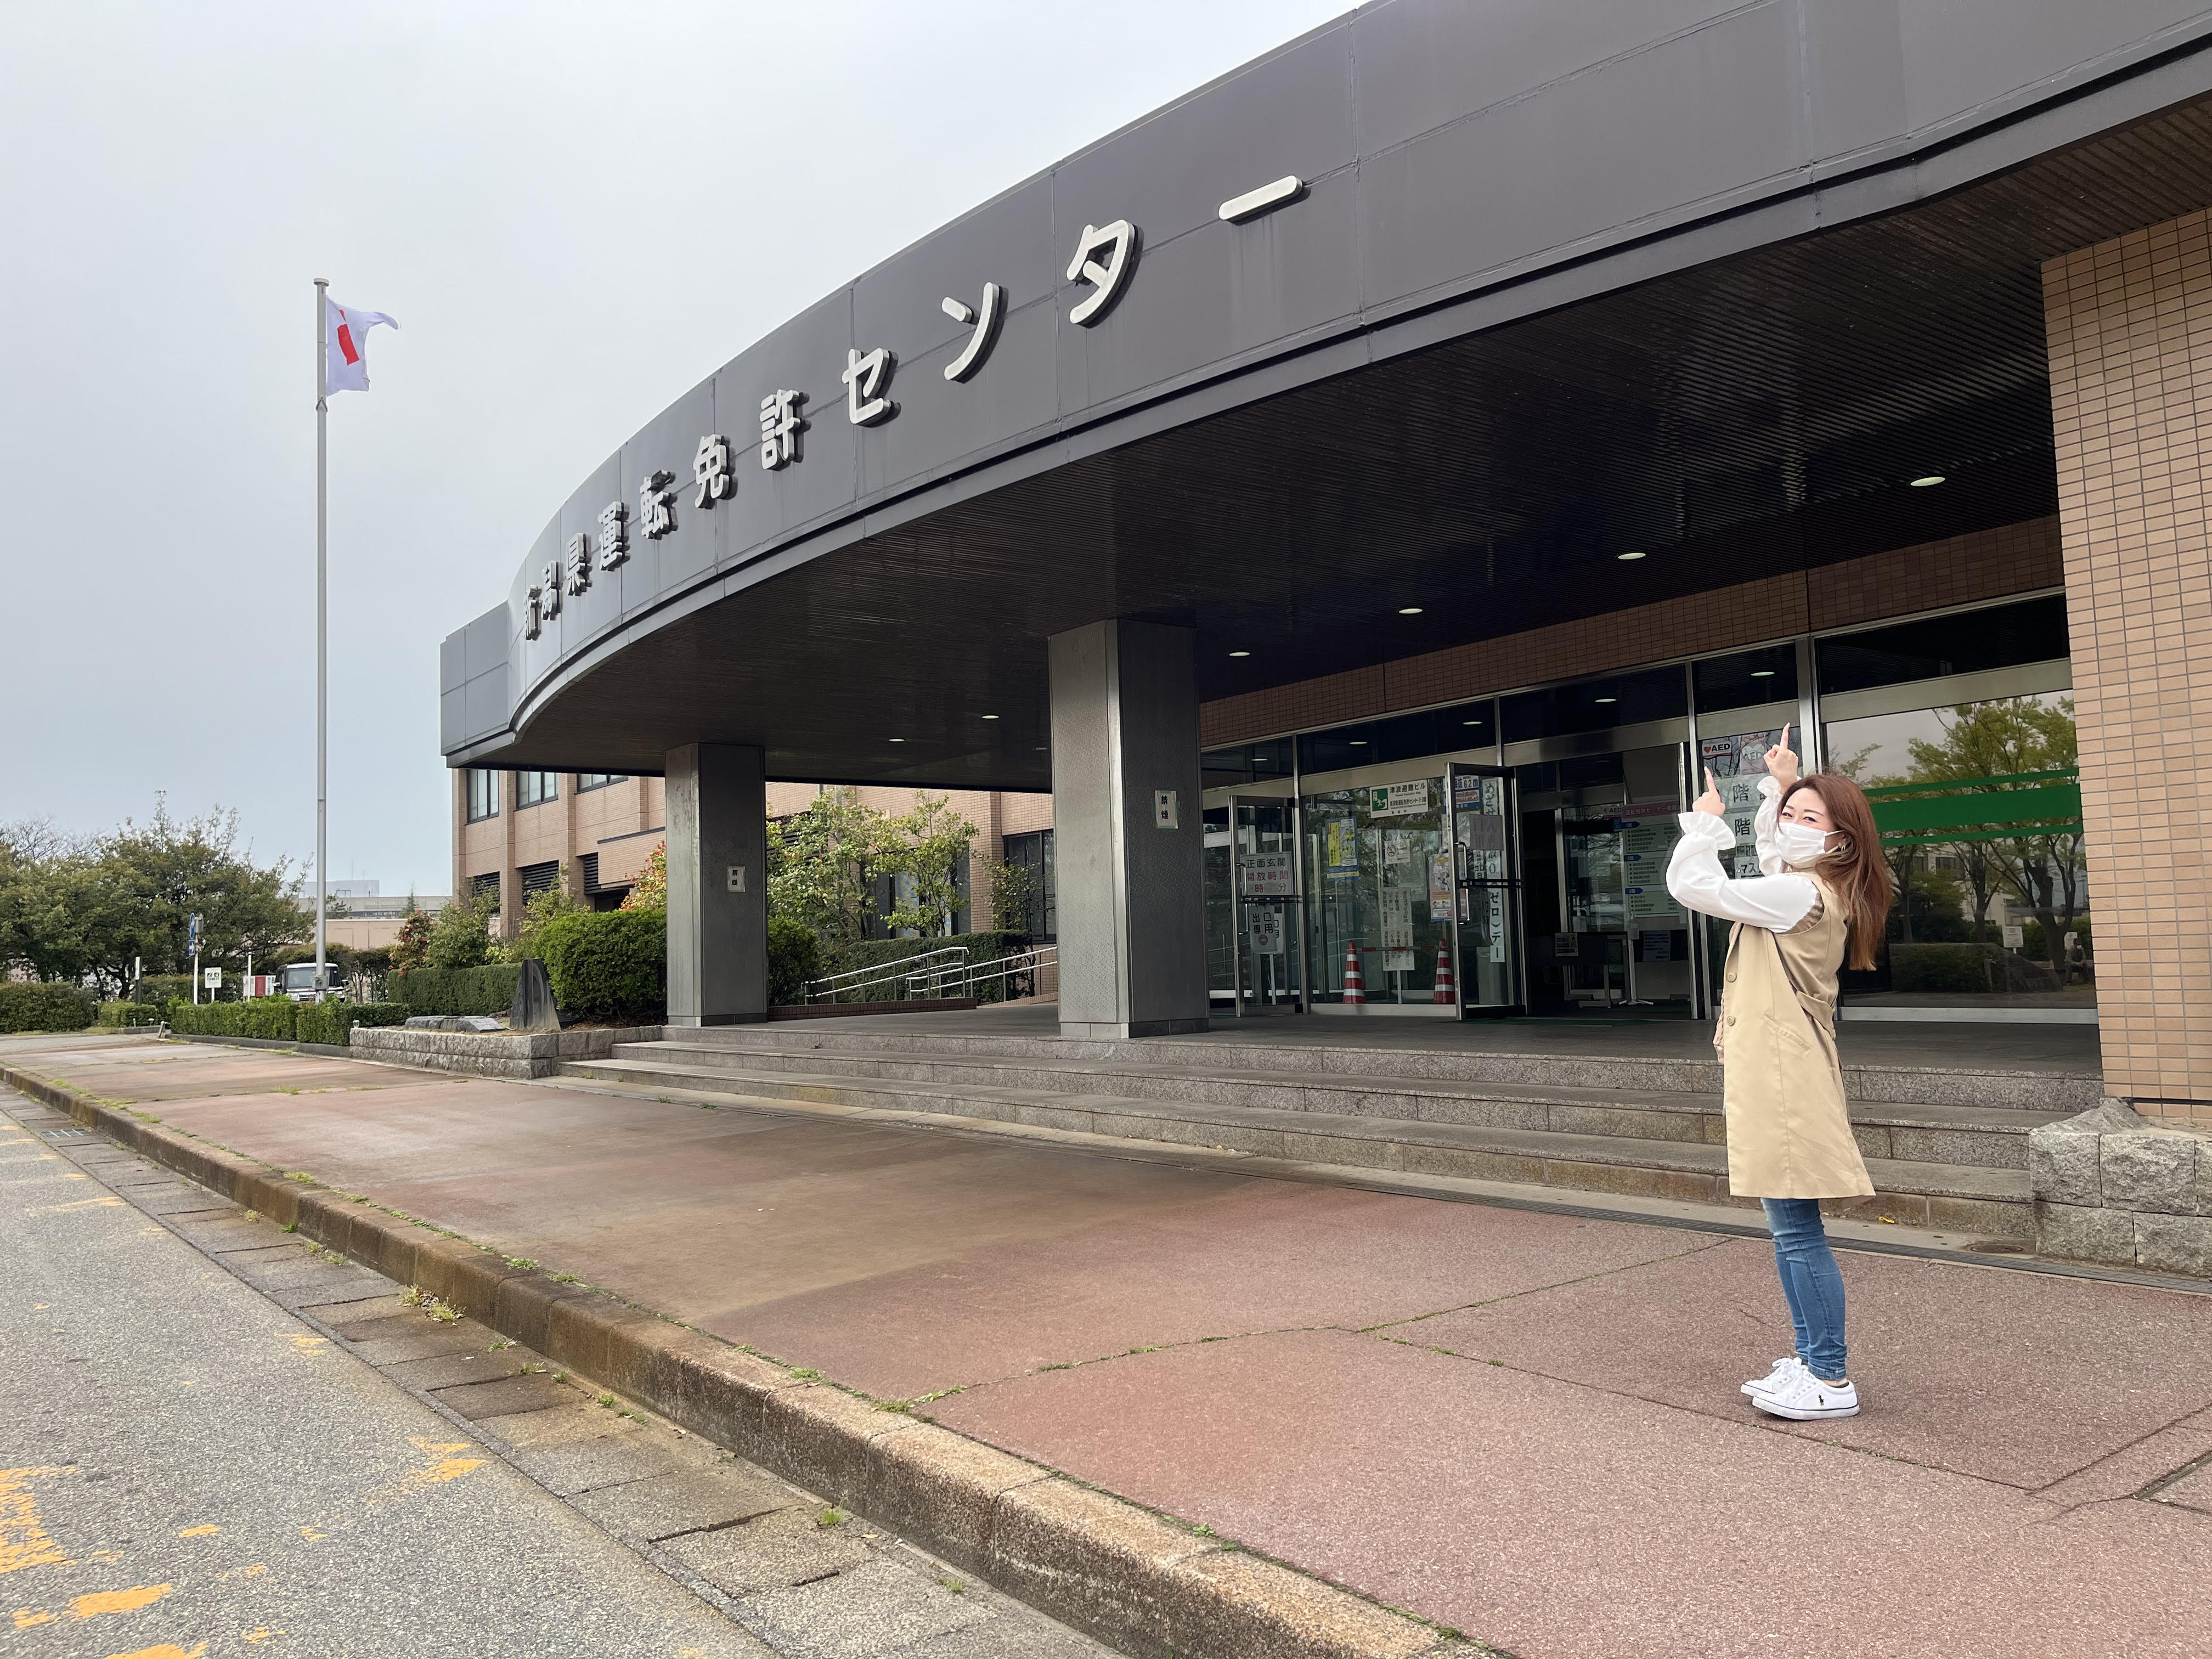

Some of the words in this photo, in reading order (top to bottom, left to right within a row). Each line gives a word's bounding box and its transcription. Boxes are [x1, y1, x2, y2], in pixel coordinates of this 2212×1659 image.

[1711, 743, 1730, 752] AED
[1390, 782, 1426, 793] 津波避難ビル
[1161, 795, 1169, 820] 禁煙
[1247, 857, 1286, 868] 正面玄関
[1741, 862, 1762, 874] マス
[1246, 870, 1289, 882] 開放時間
